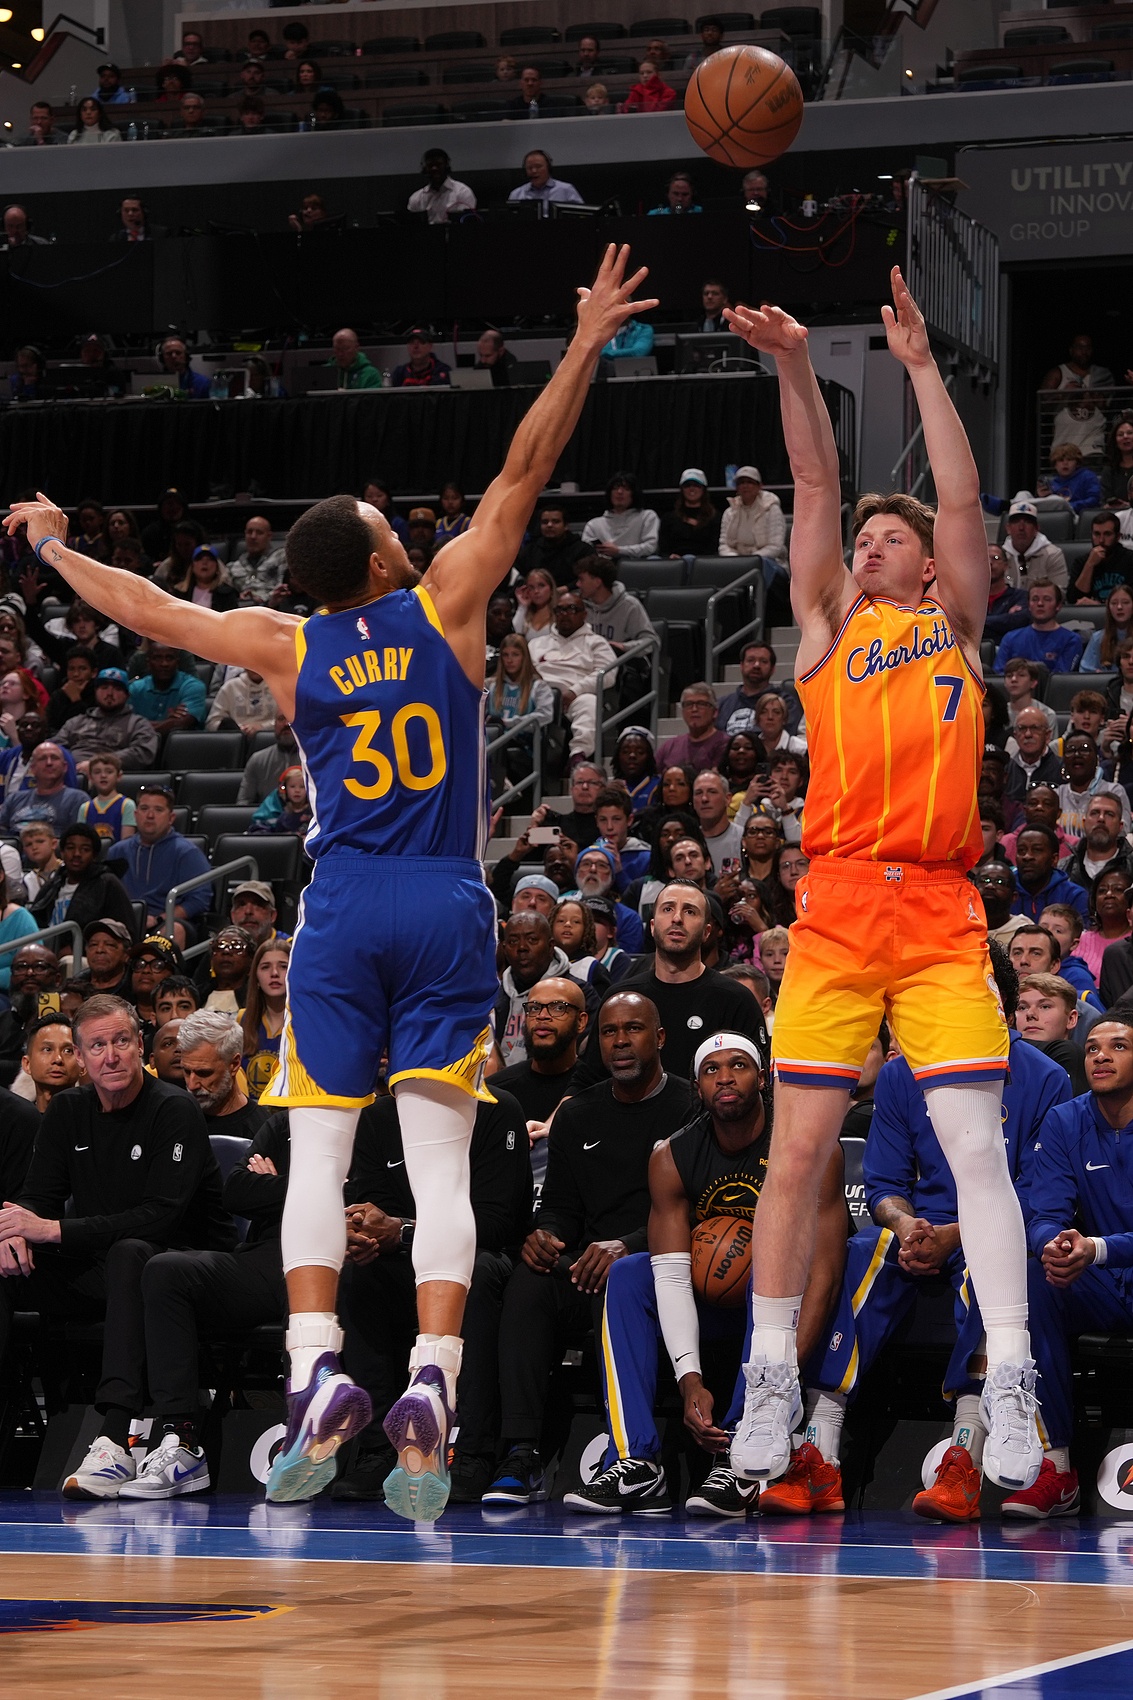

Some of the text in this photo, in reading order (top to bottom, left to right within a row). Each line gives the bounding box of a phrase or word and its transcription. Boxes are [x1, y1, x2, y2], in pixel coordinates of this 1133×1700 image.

[1011, 162, 1133, 191] UTILITY
[1050, 191, 1133, 215] INNOV
[1010, 220, 1090, 241] GROUP
[329, 647, 414, 696] CURRY
[933, 675, 965, 722] 7
[338, 702, 447, 800] 30
[713, 1225, 753, 1280] Wilson
